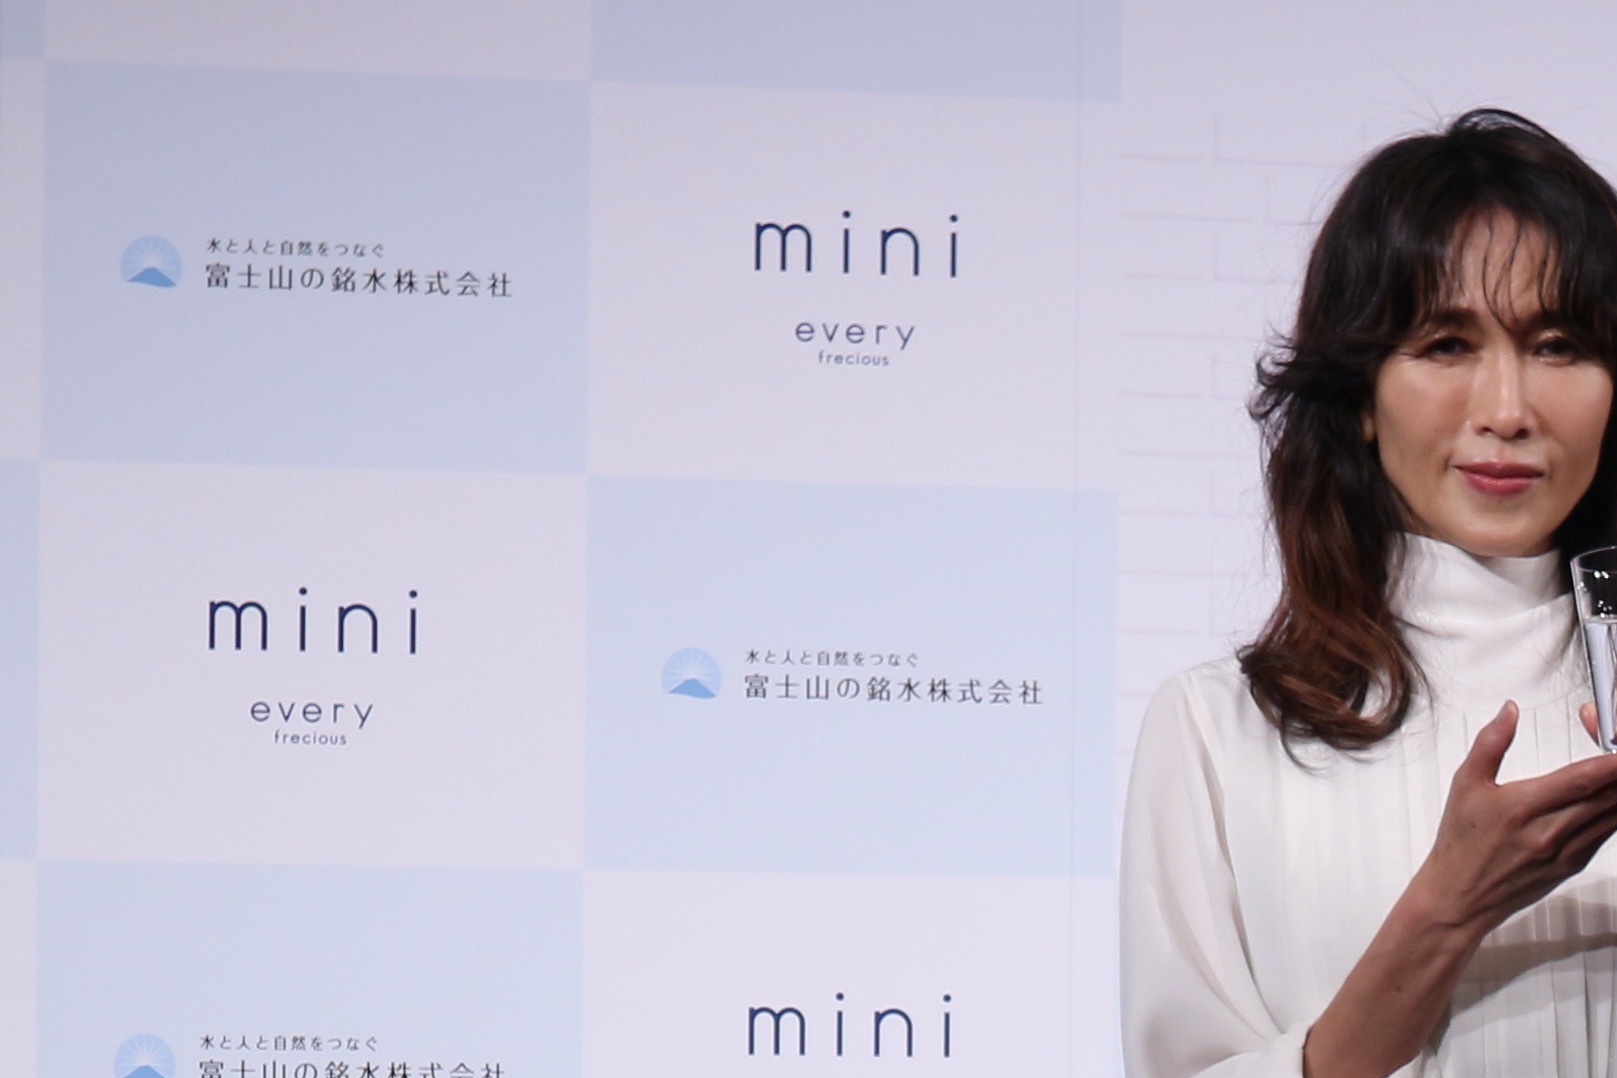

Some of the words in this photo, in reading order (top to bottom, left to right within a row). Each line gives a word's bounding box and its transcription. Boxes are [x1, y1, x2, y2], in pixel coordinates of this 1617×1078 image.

[207, 238, 383, 258] 水と人と自然をつなぐ
[755, 210, 958, 277] mini
[205, 263, 509, 297] 富士山の銘水株式会社
[795, 322, 915, 350] every
[818, 350, 889, 366] frecious
[209, 587, 417, 654] mini
[746, 649, 917, 667] 水と人と自然をつなぐ
[745, 674, 1041, 704] 富士山の銘水株式会社
[250, 702, 373, 729] every
[275, 729, 346, 745] frecious
[749, 993, 951, 1057] mini
[201, 1035, 376, 1051] 水と人と自然をつなぐ
